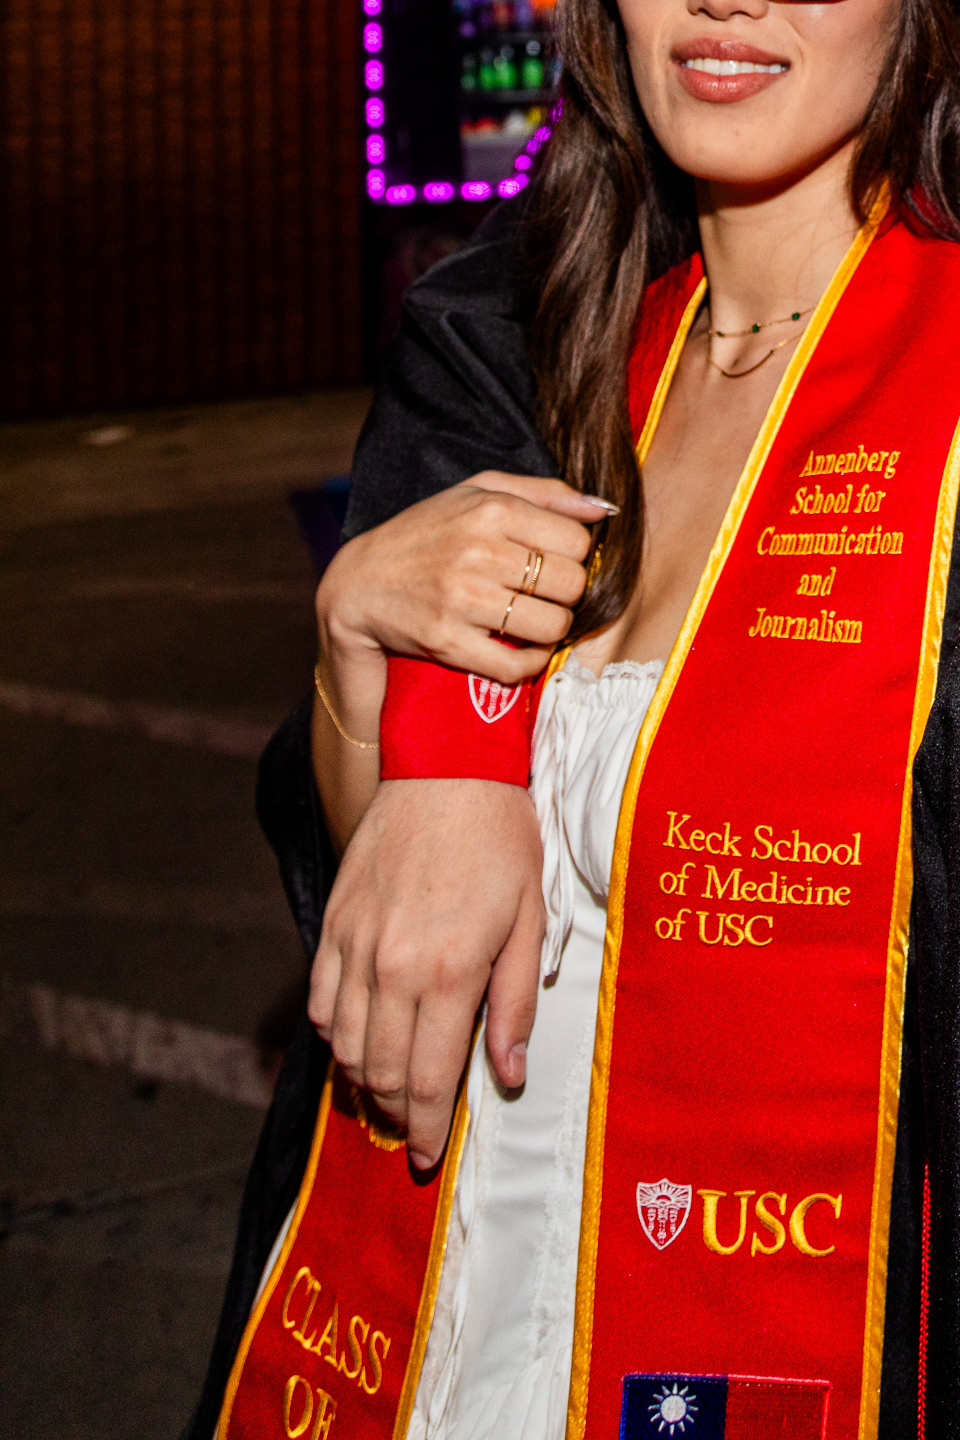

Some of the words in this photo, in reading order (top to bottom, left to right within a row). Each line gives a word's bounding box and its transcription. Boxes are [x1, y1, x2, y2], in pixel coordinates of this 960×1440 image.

[799, 444, 901, 479] Annenberg
[790, 483, 853, 515] School
[853, 483, 886, 514] for
[756, 525, 904, 556] Communication
[796, 566, 837, 597] and
[748, 607, 863, 644] Journalism
[662, 811, 743, 857] Keck
[751, 824, 862, 866] School
[659, 861, 697, 896] of
[701, 864, 851, 907] Medicine
[654, 908, 692, 941] of
[696, 911, 774, 947] USC
[697, 1189, 843, 1258] USC
[281, 1266, 392, 1395] CLASS
